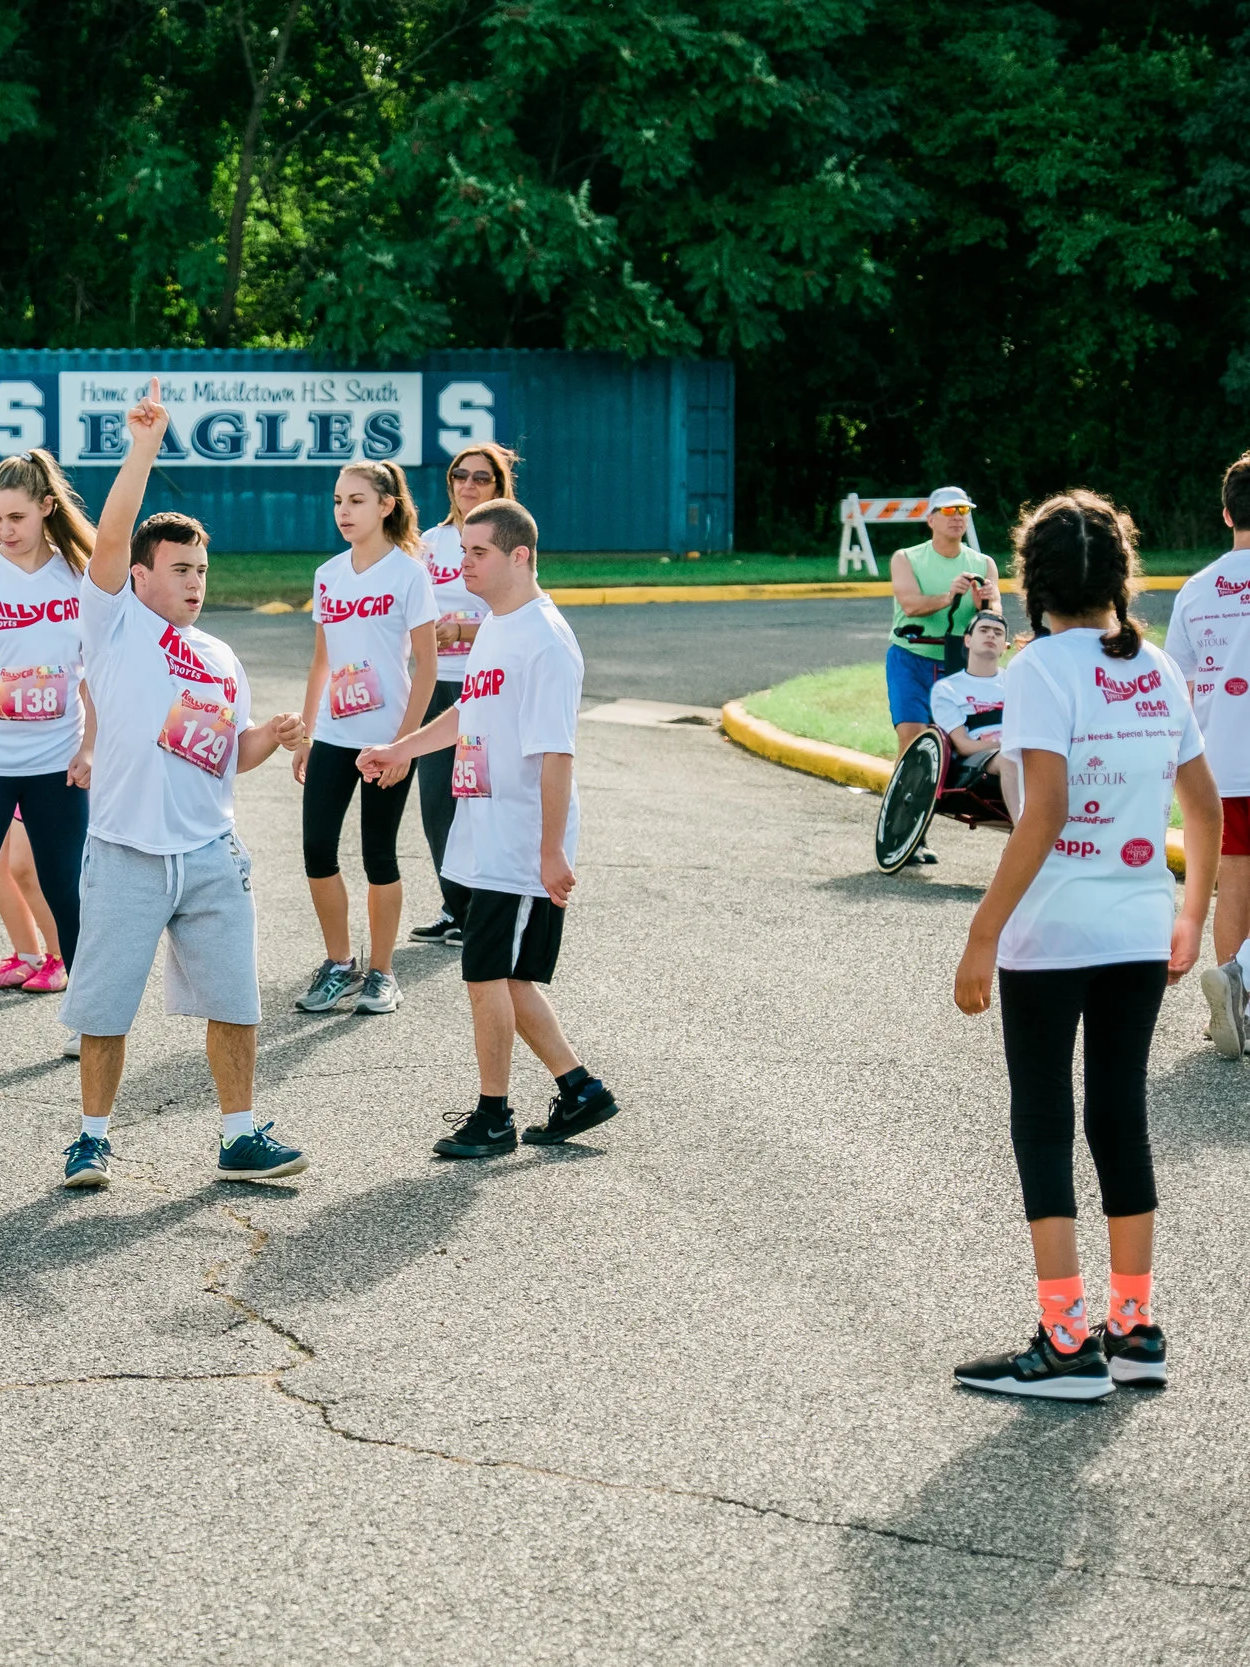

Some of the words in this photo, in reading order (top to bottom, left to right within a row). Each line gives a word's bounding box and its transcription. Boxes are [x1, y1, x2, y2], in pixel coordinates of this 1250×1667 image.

[81, 380, 128, 401] Home
[160, 381, 186, 401] the
[193, 381, 295, 402] Middletown
[345, 379, 401, 402] South
[438, 381, 495, 457] S
[320, 583, 395, 619] ALLYCAP
[169, 658, 202, 680] Sports
[10, 687, 58, 713] 138
[336, 682, 370, 710] 145
[1135, 700, 1168, 712] COLOR
[180, 719, 228, 764] 129
[1117, 729, 1143, 740] Special
